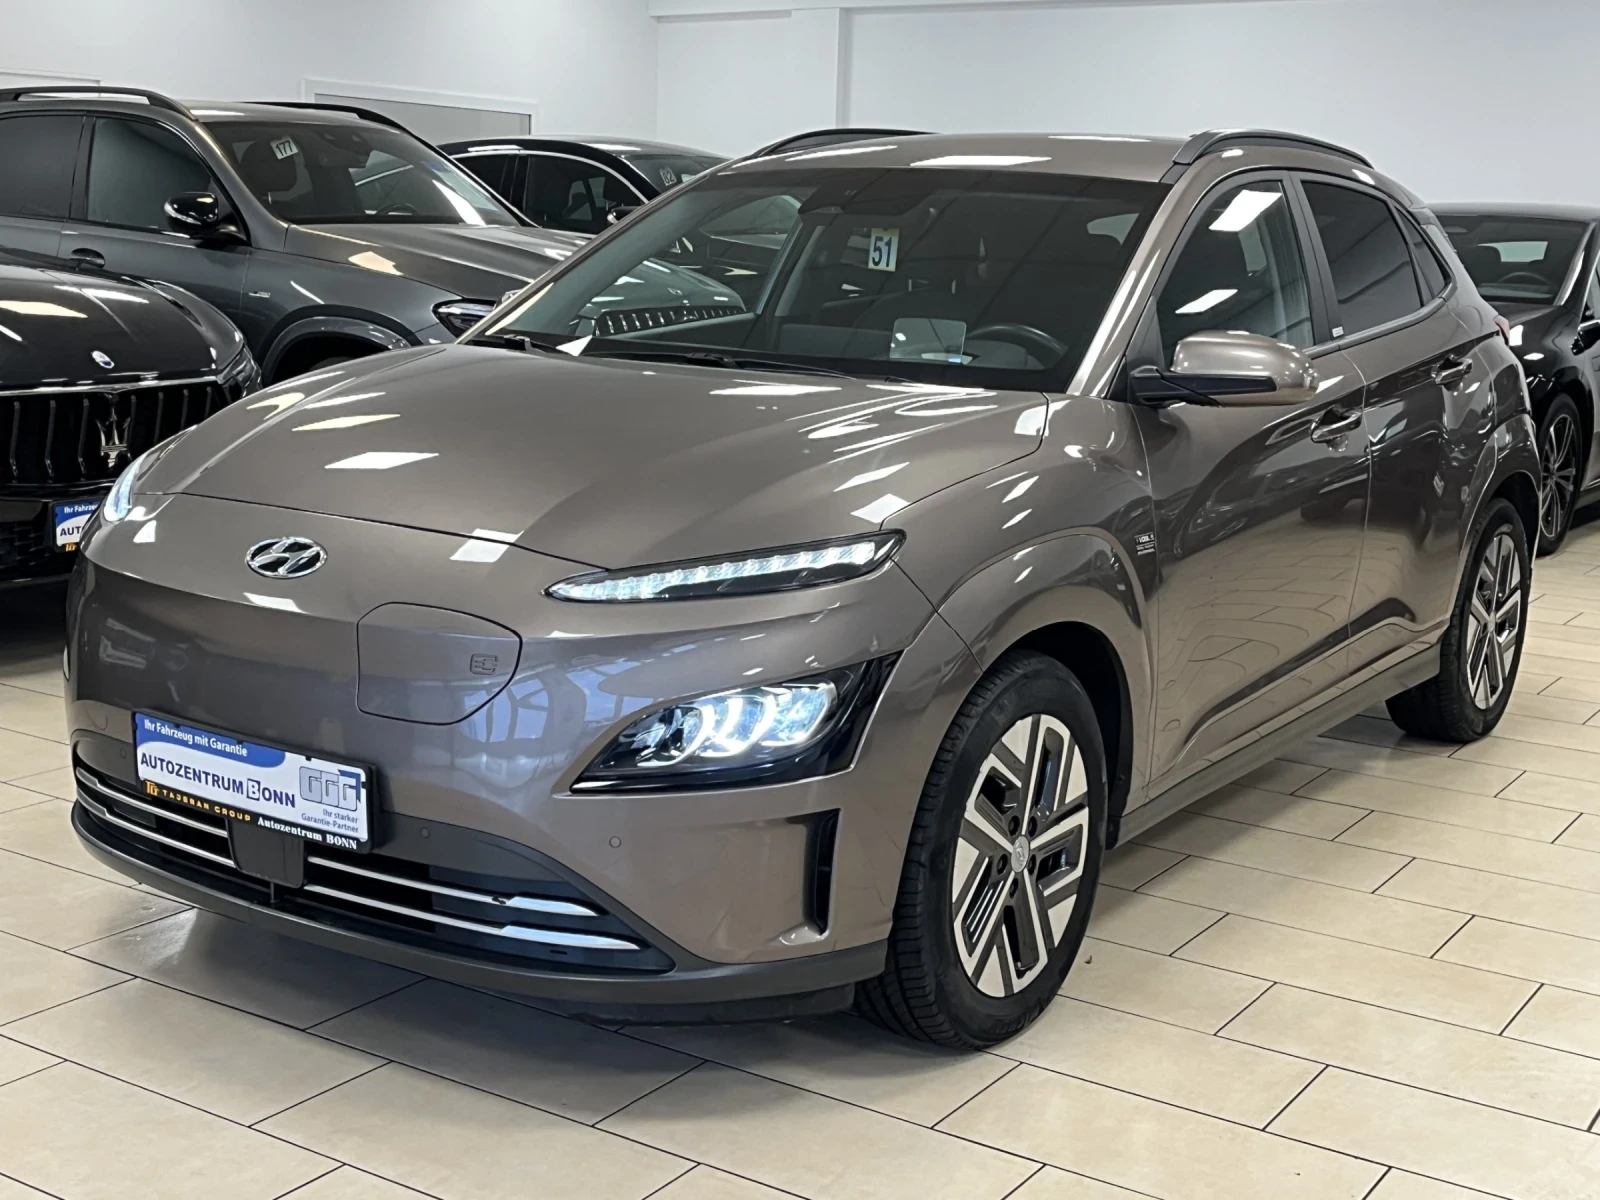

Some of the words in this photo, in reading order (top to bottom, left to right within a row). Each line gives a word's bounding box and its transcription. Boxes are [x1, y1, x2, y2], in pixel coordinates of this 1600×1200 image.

[275, 139, 293, 157] 177
[871, 235, 893, 267] 51
[60, 526, 81, 536] AUT
[144, 718, 155, 732] Ihr
[156, 722, 193, 745] Fahrzeug
[194, 735, 209, 748] mit
[210, 738, 248, 757] Garantie
[140, 752, 244, 796] AUTOZENTRUM
[213, 805, 251, 821] GROUP
[257, 816, 323, 842] Autozentrum
[325, 833, 358, 850] BONN
[301, 812, 359, 834] Garantie-Partner
[322, 808, 333, 818] Ihr
[333, 813, 359, 824] starker
